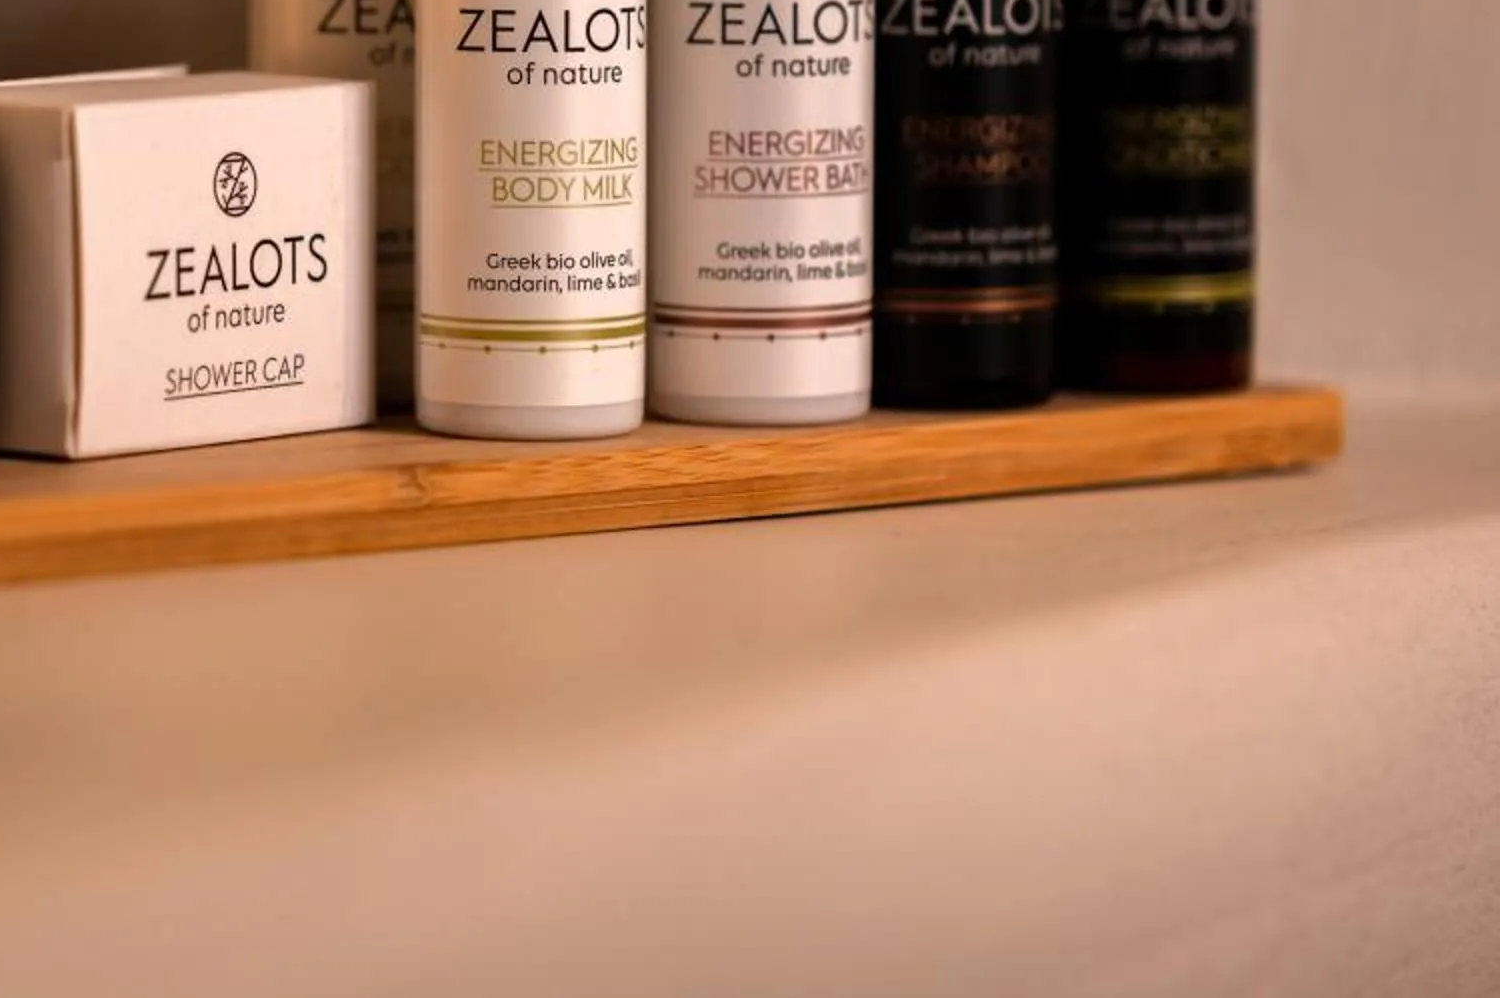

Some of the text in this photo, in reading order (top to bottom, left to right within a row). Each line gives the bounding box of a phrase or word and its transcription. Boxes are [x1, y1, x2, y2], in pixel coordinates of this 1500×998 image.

[455, 6, 645, 54] ZEALOTS
[507, 62, 622, 85] of nature
[736, 53, 852, 78] of nature
[480, 136, 638, 166] ENERGIZING
[708, 124, 864, 156] ENERGIZING
[492, 172, 633, 203] BODY MILK
[694, 165, 820, 193] SHOWER
[486, 253, 541, 270] Greek
[547, 252, 576, 270] bio
[579, 251, 616, 269] olive
[716, 241, 772, 259] Greek
[775, 241, 806, 260] bio
[144, 233, 328, 301] ZEALOTS
[698, 262, 793, 282] mandarin,
[796, 263, 833, 280] lime
[468, 275, 563, 294] mandarin,
[567, 274, 603, 291] lime
[605, 272, 617, 290] &
[187, 301, 286, 334] of nature
[164, 353, 305, 395] SHOWER CAP
